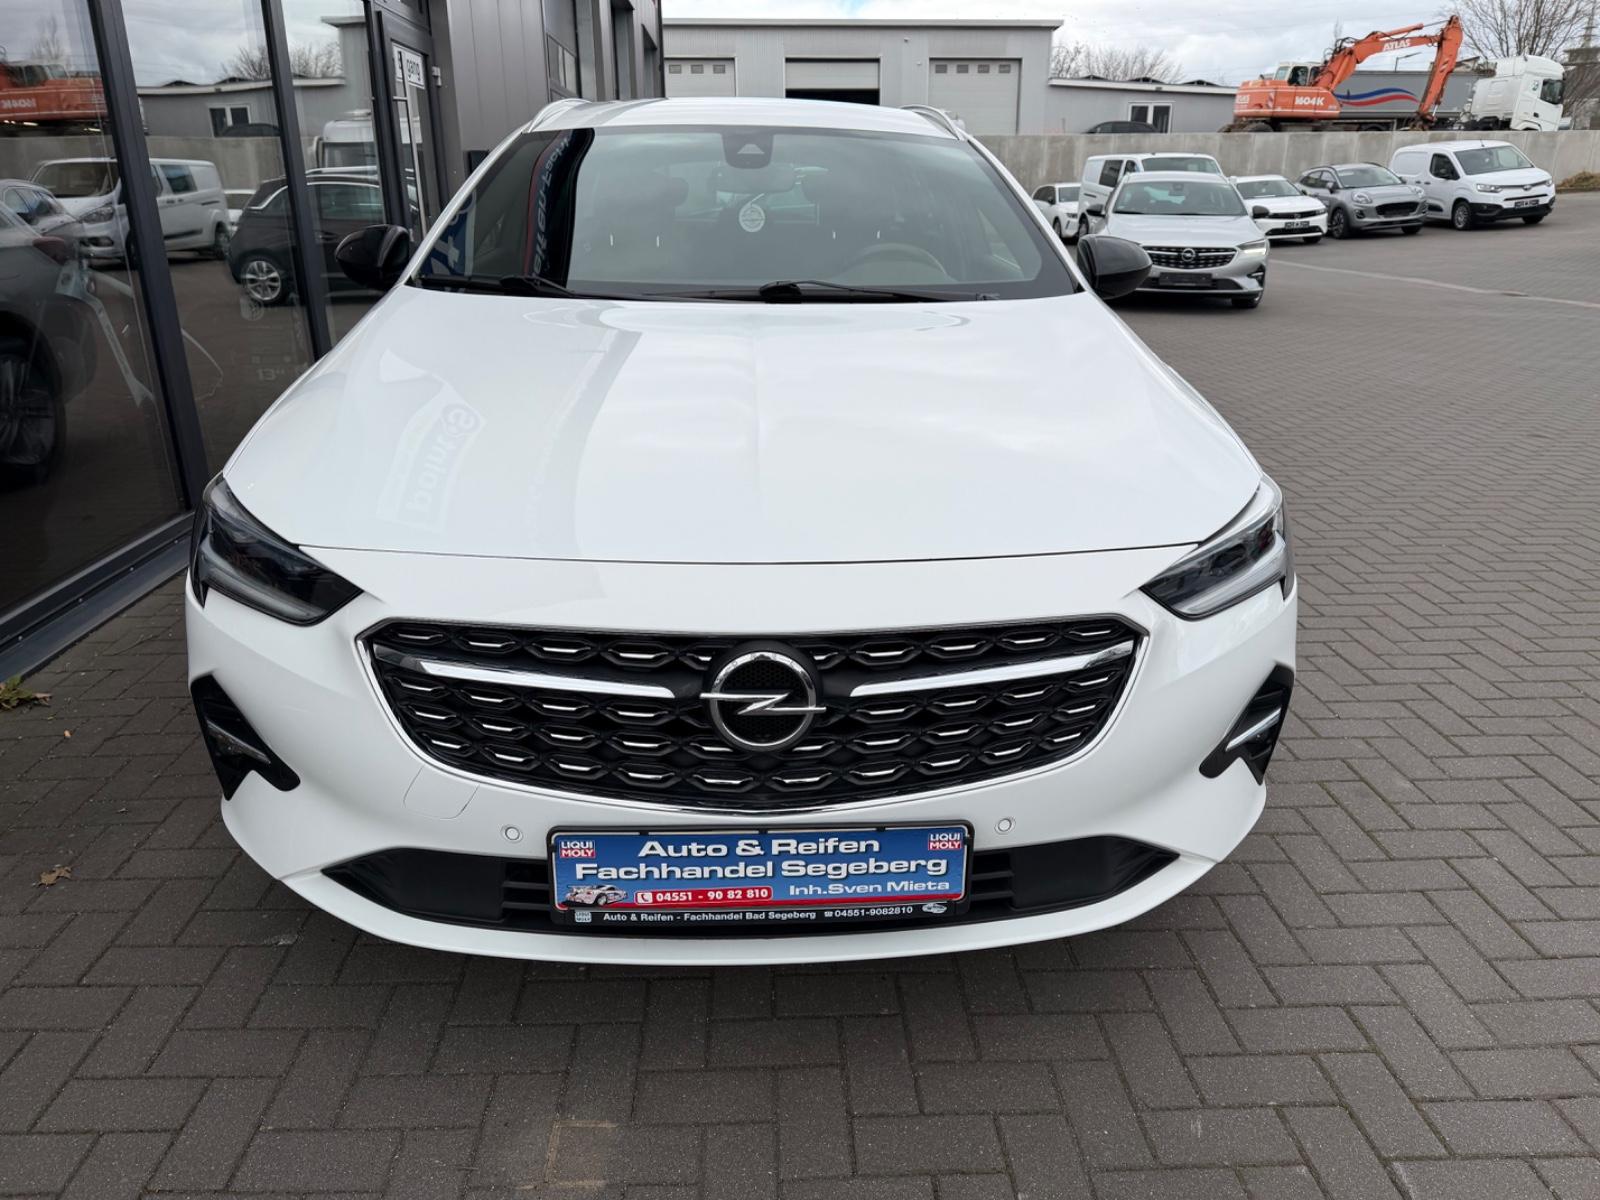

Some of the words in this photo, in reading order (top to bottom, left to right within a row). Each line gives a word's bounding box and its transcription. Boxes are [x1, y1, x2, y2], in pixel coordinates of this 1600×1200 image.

[1383, 39, 1411, 51] ATLAS
[1295, 96, 1325, 106] 1604K
[930, 833, 960, 841] LIQUI
[561, 841, 593, 849] LIQUI
[638, 841, 728, 857] Auto
[735, 839, 765, 856] &
[771, 837, 880, 855] Reifen
[930, 841, 961, 850] MOLY
[561, 849, 594, 857] MOLY
[576, 861, 773, 880] Fachhandel
[781, 857, 948, 879] Segeberg
[887, 880, 950, 892] Mieta
[656, 891, 692, 902] 04551
[707, 891, 723, 900] 90
[727, 889, 742, 899] 82
[746, 888, 768, 898] 810
[603, 913, 628, 921] Auto
[630, 913, 639, 921] &
[640, 913, 674, 921] Reifen
[684, 912, 743, 921] Fachhandel
[745, 912, 765, 920] Bad
[768, 911, 816, 920] Segeberg
